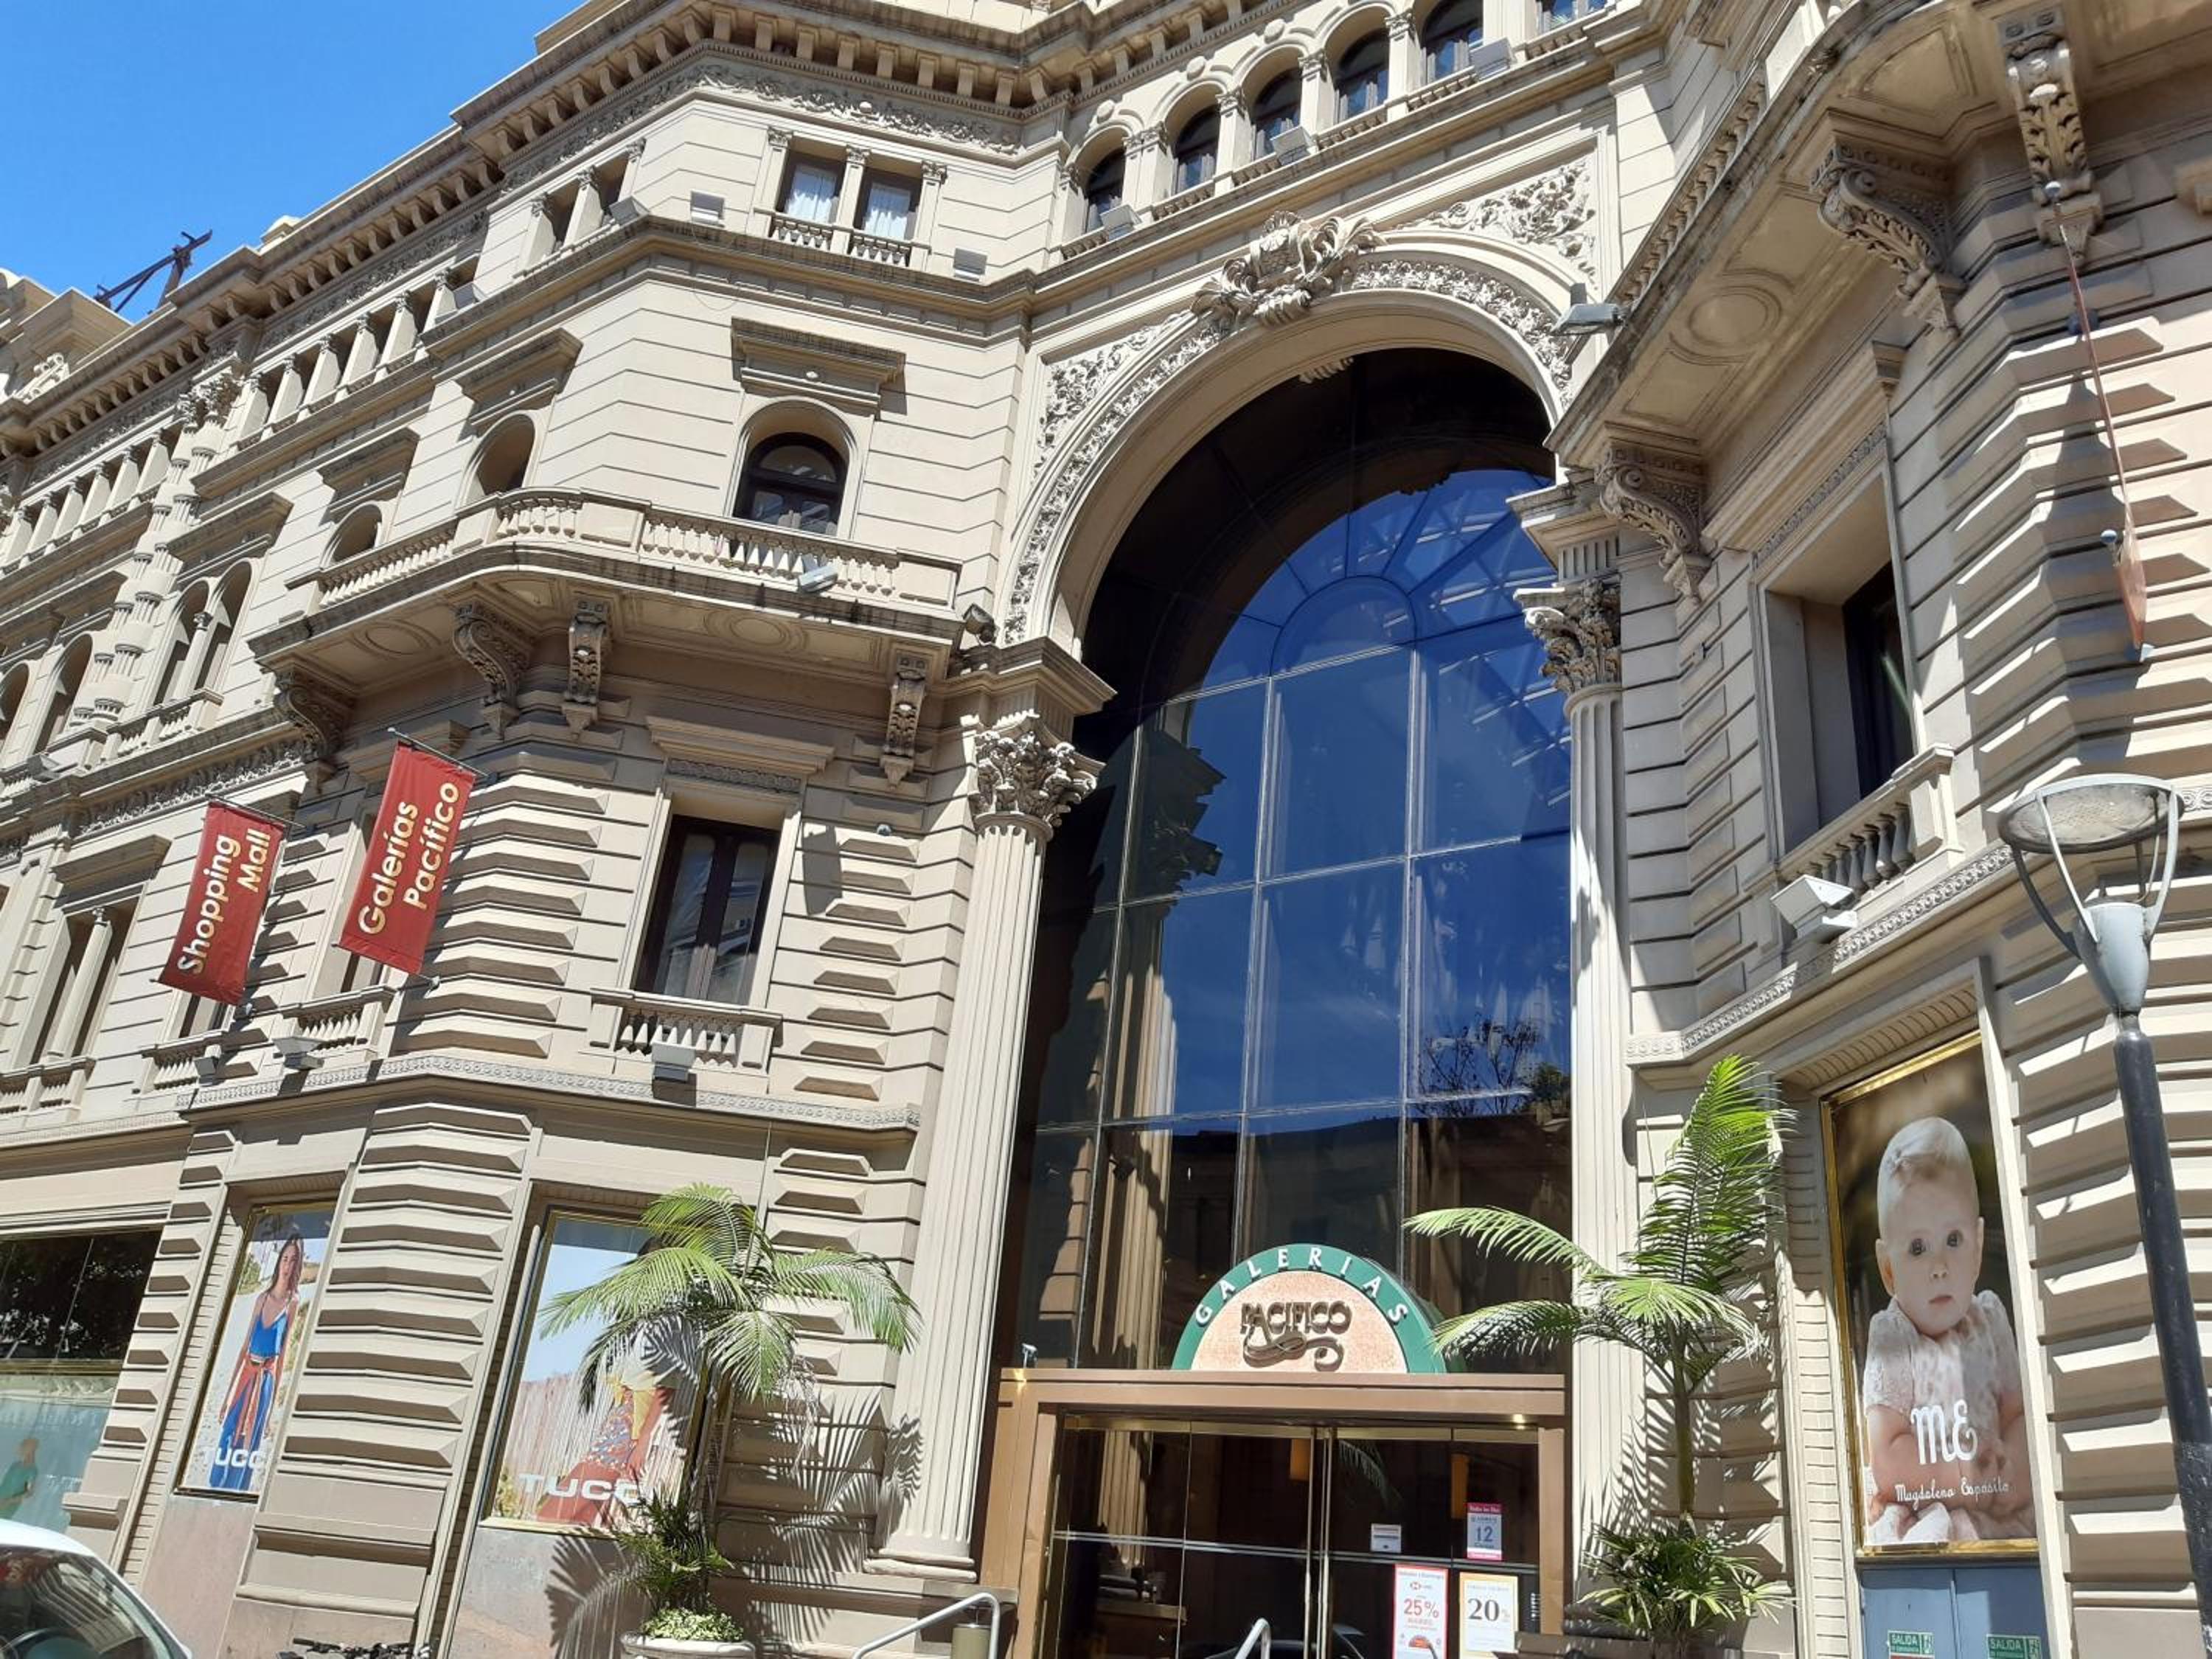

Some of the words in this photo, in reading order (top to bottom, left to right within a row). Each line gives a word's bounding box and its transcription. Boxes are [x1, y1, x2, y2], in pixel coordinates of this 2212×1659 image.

[237, 828, 271, 893] Mall
[358, 801, 418, 934] Galerías
[403, 782, 460, 910] Pacífico
[177, 835, 241, 974] Shopping
[1194, 1247, 1408, 1326] GALERIAS
[1240, 1300, 1353, 1371] PACIFICO
[1910, 1399, 1978, 1465] ME
[1894, 1478, 1955, 1510] Magdalena
[1476, 1526, 1493, 1543] 12
[1403, 1598, 1439, 1618] 25%
[1891, 1633, 1917, 1646] SALIDA
[1990, 1638, 2021, 1650] SALIDA
